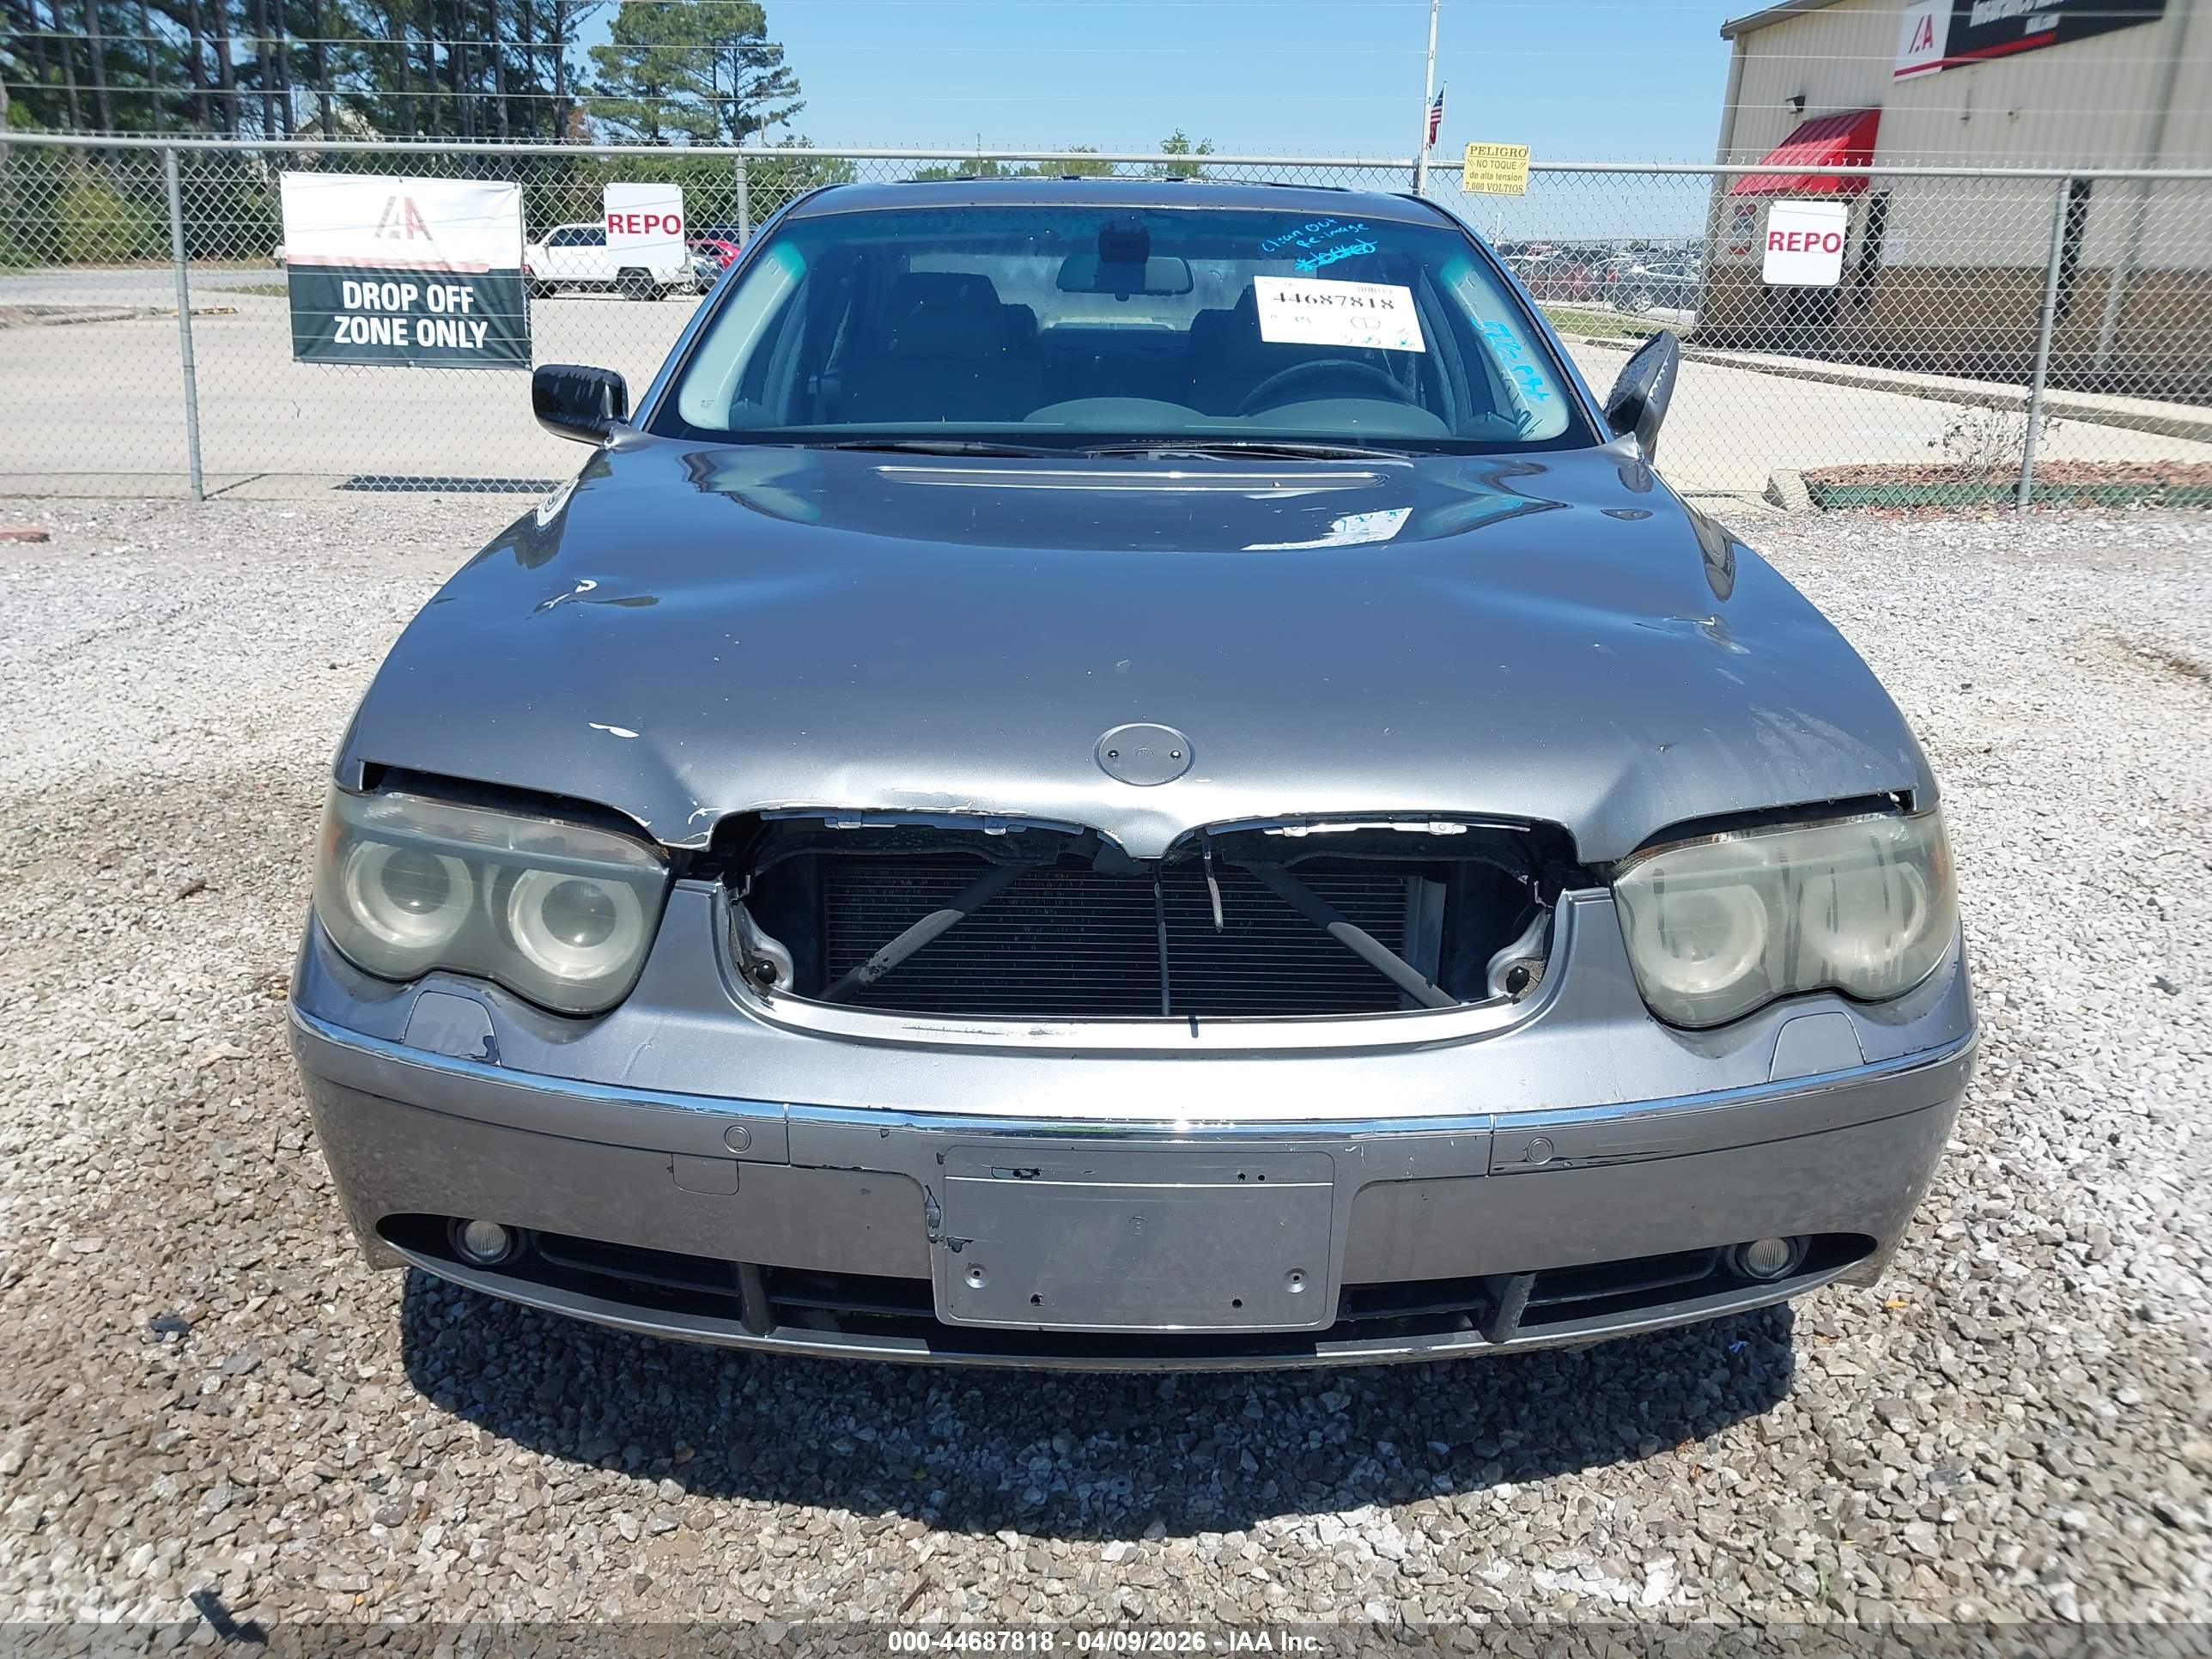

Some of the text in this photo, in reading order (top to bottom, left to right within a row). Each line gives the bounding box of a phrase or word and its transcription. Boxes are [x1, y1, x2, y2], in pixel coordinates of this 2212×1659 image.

[1469, 145, 1528, 158] PELIGRO
[1476, 159, 1517, 170] NO TOQUE
[1469, 171, 1479, 179] de
[1480, 171, 1494, 180] alta
[1465, 181, 1524, 193] 7,000 VOLTIOS
[607, 213, 682, 235] REPO
[1768, 230, 1843, 254] REPO
[342, 280, 474, 314] DROP OFF
[1273, 291, 1395, 310] 44687818
[333, 315, 489, 349] ZONE ONLY
